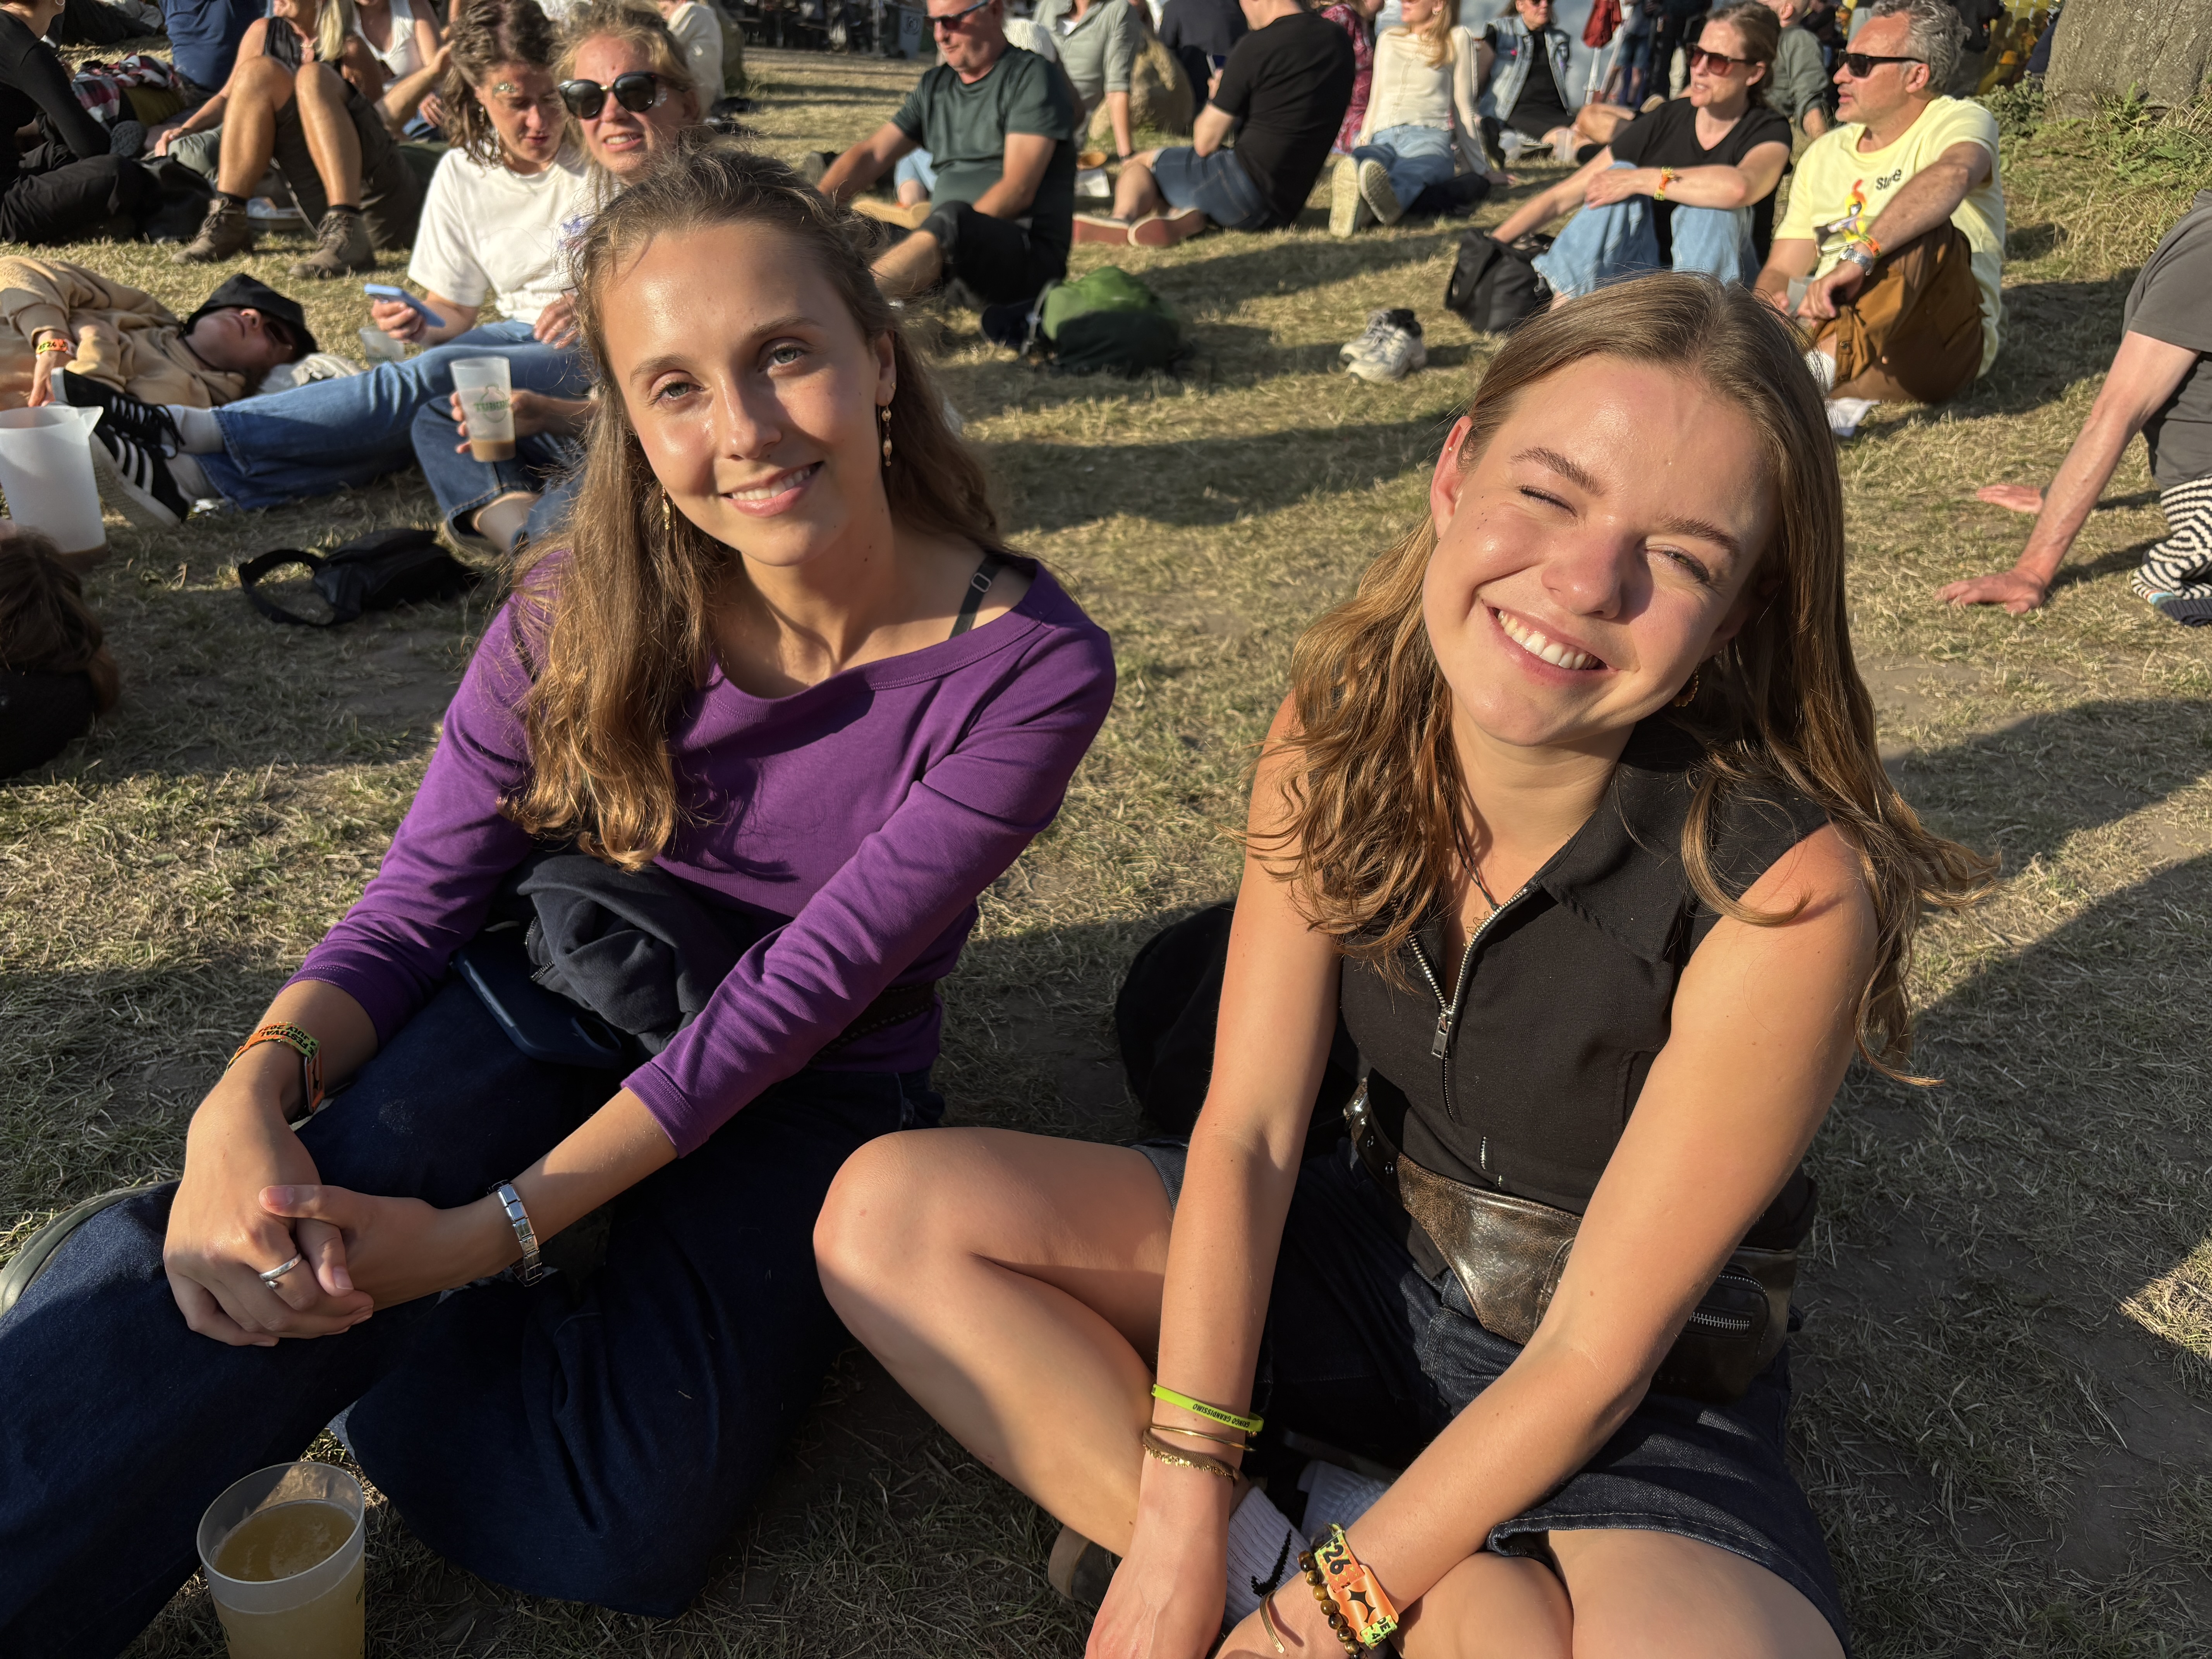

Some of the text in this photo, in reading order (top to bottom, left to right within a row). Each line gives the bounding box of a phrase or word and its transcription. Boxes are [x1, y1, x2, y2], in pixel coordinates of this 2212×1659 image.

[261, 1030, 308, 1049] FESTIVAL
[287, 1026, 310, 1041] JULY
[1193, 1403, 1250, 1428] GRINGO GRANDISSIMO
